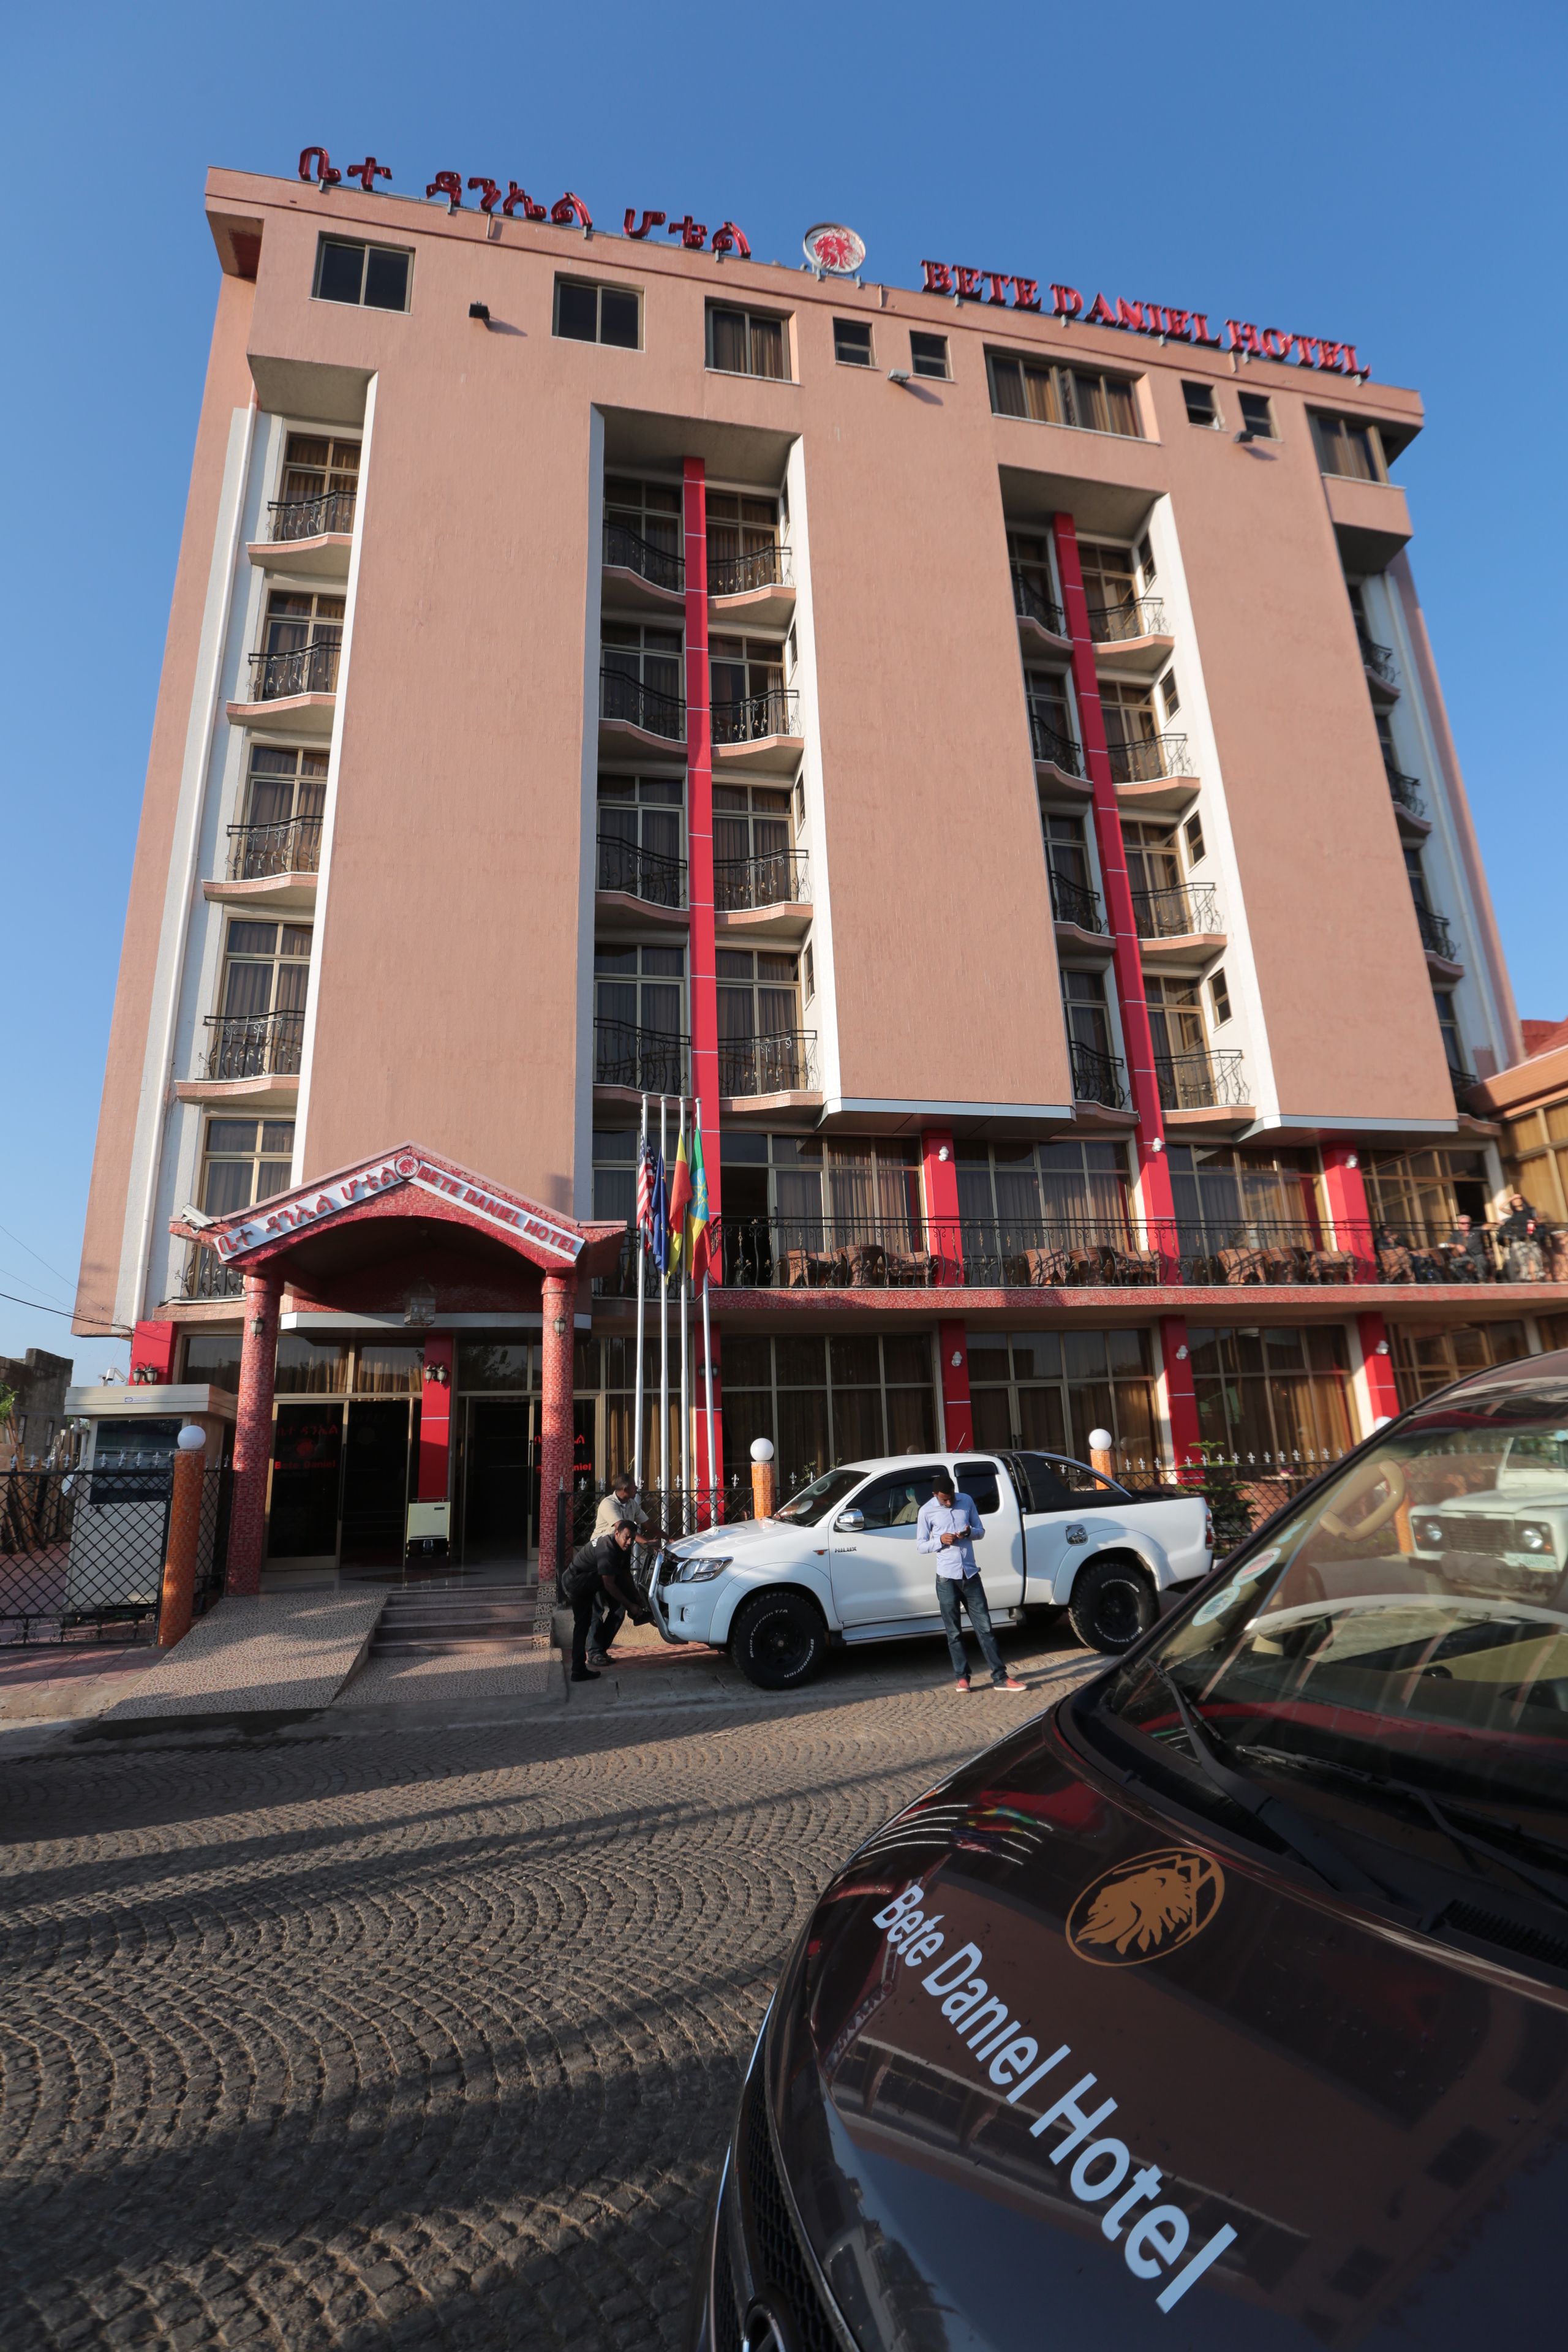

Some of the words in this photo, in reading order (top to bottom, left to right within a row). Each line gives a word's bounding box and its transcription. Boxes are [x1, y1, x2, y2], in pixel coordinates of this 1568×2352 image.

[299, 146, 392, 192] ቤተ
[426, 170, 592, 230] ዳንኤል
[624, 208, 752, 259] ሆቴል
[921, 259, 1042, 312] BETE
[1049, 284, 1222, 349] DANIEL
[1225, 318, 1371, 380] HOTEL
[218, 1229, 253, 1254] ቤተ
[266, 1194, 335, 1232] ዳንኤል
[341, 1166, 398, 1200] ሆቴል
[417, 1165, 462, 1197] BETE
[462, 1188, 520, 1227] DANIEL
[524, 1218, 576, 1255] HOTEL
[304, 1460, 336, 1469] Daniel
[872, 1884, 944, 1967] Bete
[1029, 2073, 1238, 2315] Hotel
